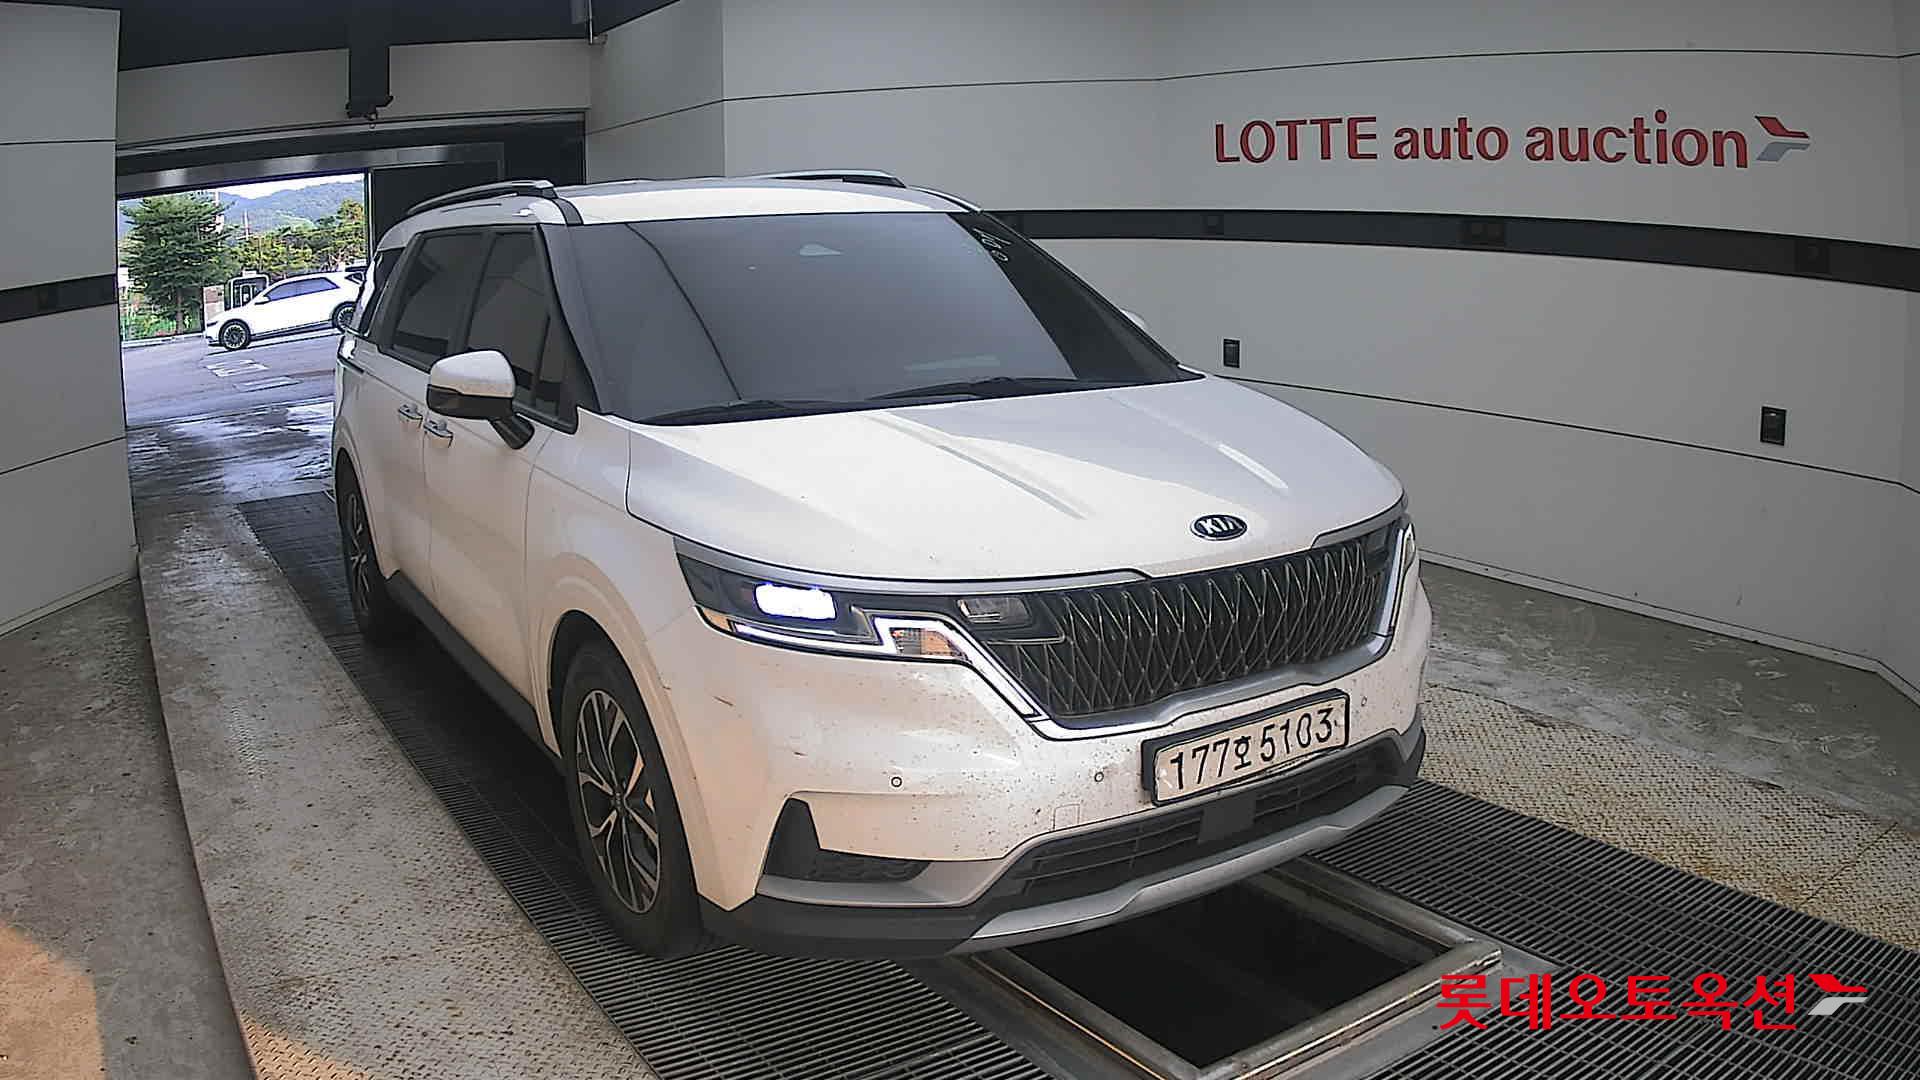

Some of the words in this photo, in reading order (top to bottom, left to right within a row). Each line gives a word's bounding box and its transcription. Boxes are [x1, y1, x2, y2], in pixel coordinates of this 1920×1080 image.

[1215, 116, 1377, 164] LOTTE
[1392, 118, 1509, 161] auto
[1524, 109, 1748, 168] auction
[1199, 516, 1243, 534] KIA
